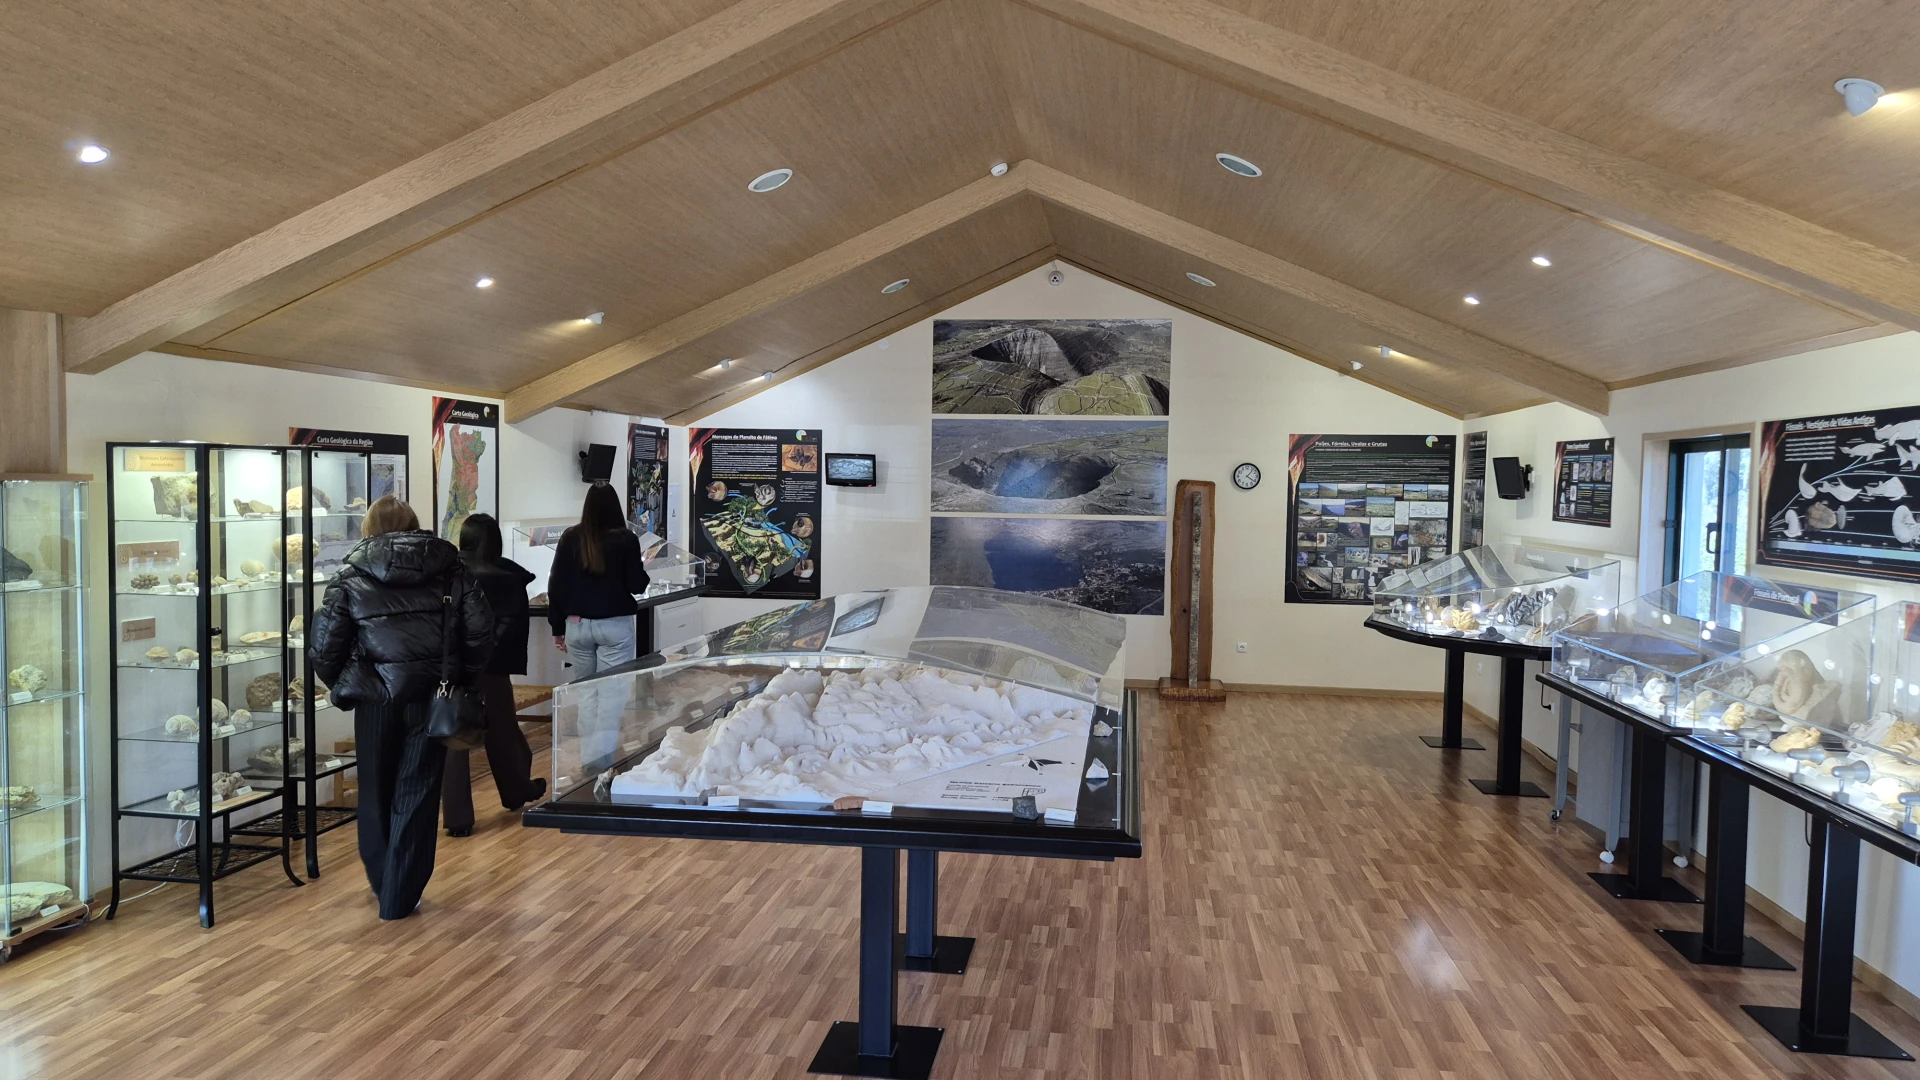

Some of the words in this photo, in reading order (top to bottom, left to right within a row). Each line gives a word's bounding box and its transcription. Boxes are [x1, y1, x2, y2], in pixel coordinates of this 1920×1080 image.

[1830, 418, 1838, 428] de
[316, 436, 330, 444] Carta
[330, 436, 352, 446] Geológica
